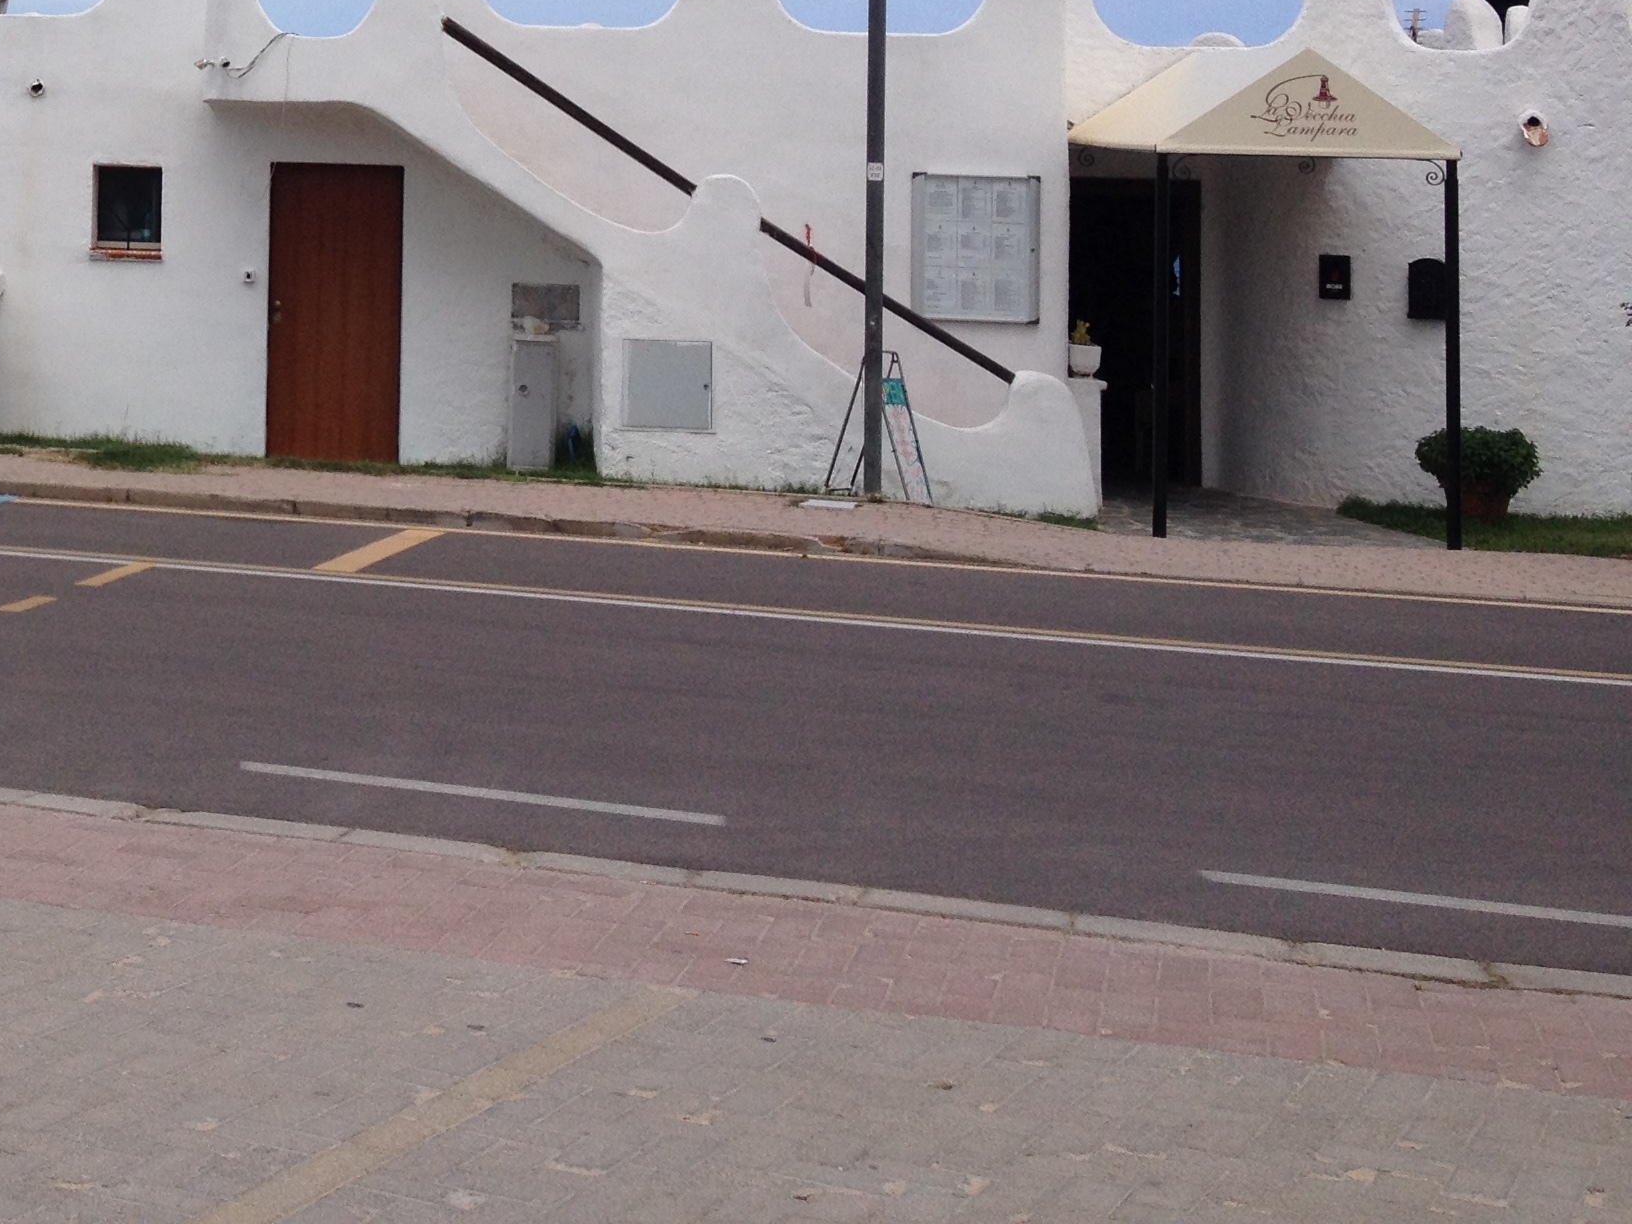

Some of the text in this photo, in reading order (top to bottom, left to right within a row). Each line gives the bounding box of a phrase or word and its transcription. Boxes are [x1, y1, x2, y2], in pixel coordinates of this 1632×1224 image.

[1250, 93, 1356, 123] La Vecchia
[1264, 117, 1358, 142] Lampara
